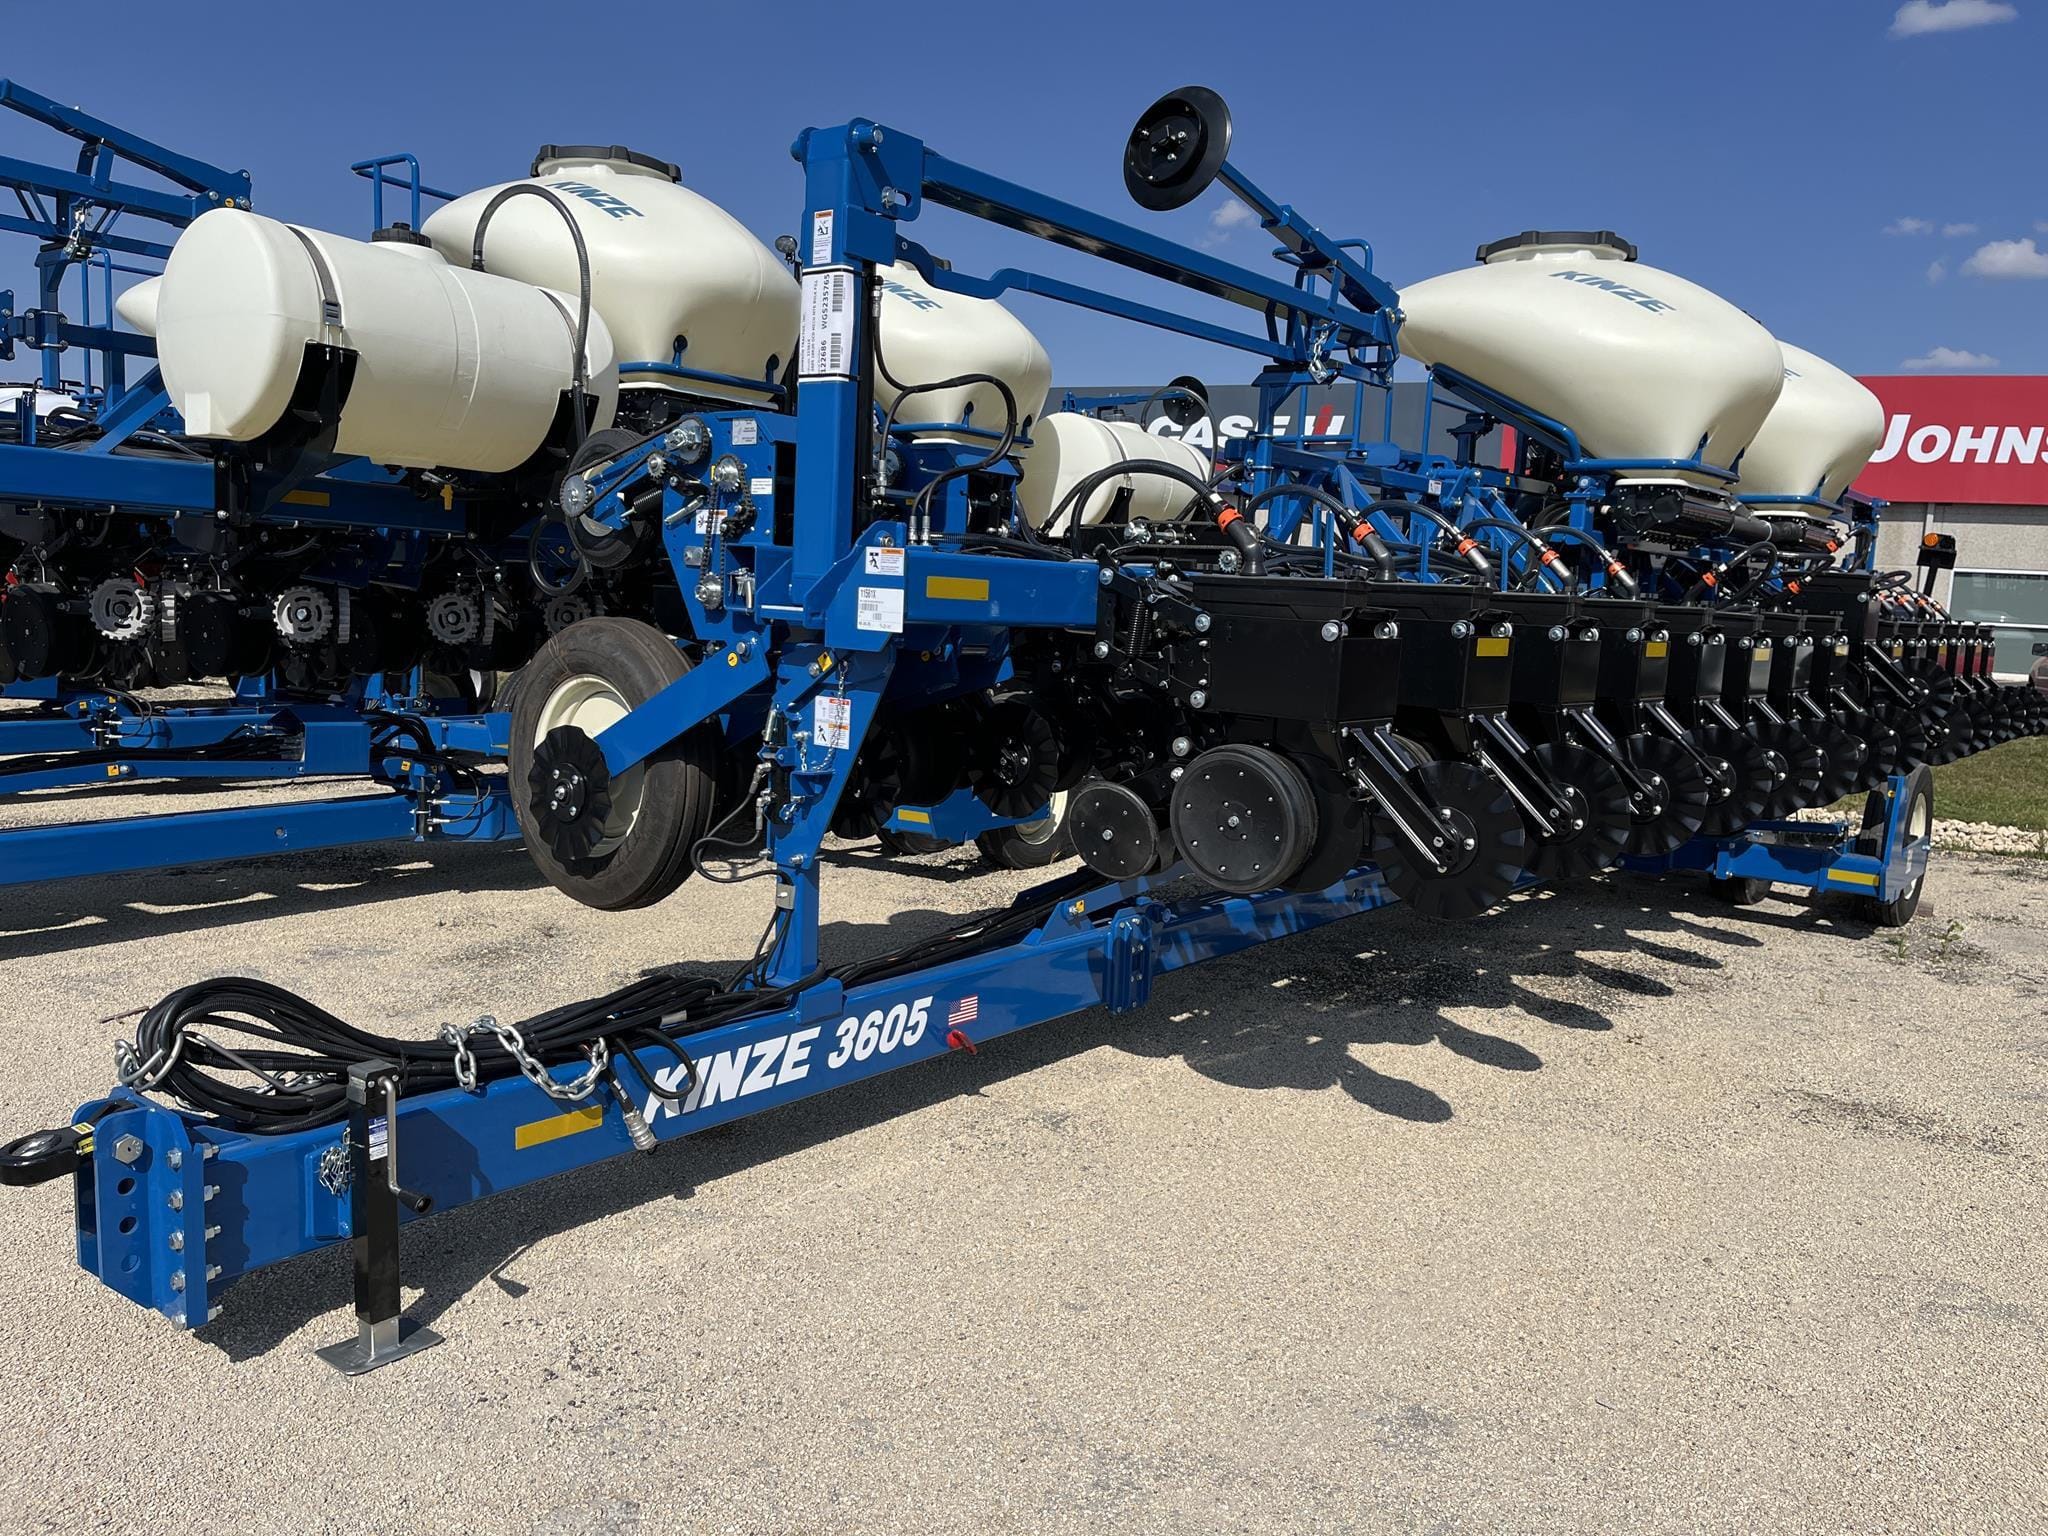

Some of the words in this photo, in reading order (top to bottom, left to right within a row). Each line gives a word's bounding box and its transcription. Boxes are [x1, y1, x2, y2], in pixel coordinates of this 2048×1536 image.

[545, 181, 645, 218] KINZE
[881, 280, 943, 310] INZE
[1548, 270, 1677, 313] KINZE
[1868, 414, 2048, 464] JOHN
[643, 1026, 822, 1124] KINZE
[828, 995, 934, 1069] 3605
